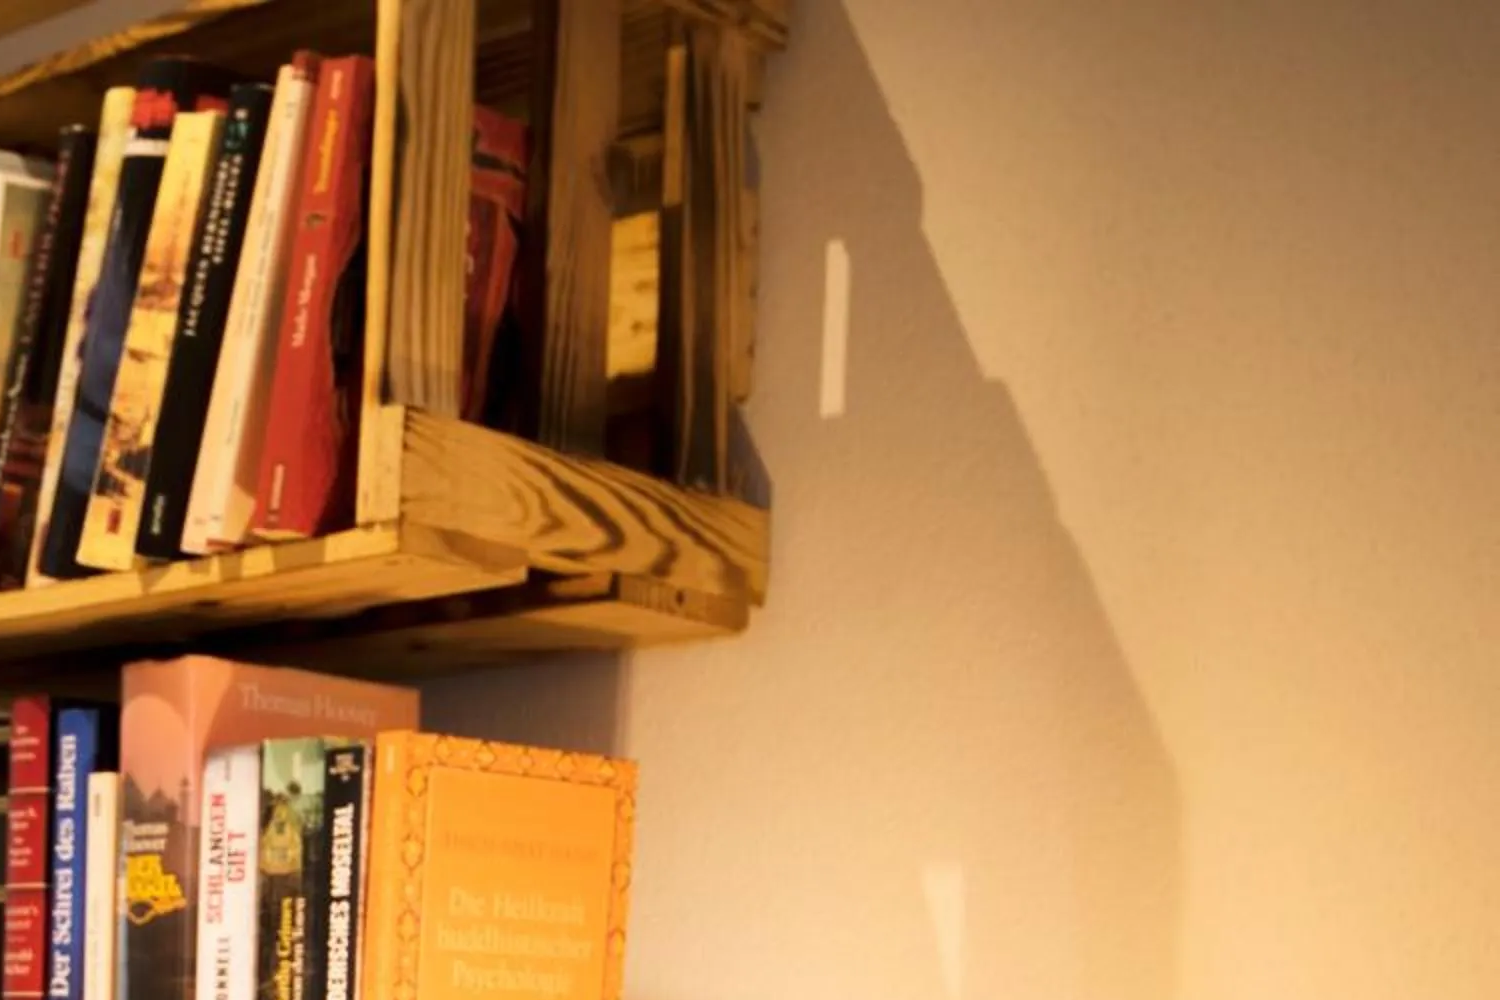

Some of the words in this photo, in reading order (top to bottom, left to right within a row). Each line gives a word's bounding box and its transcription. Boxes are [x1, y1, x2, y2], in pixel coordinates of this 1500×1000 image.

[54, 734, 78, 810] Raben
[53, 819, 75, 860] des
[205, 793, 226, 925] SCHLANGEN
[226, 829, 246, 884] GIFT
[331, 802, 355, 898] MOSELTAL
[50, 868, 74, 946] Schrei
[49, 955, 72, 1000] Der
